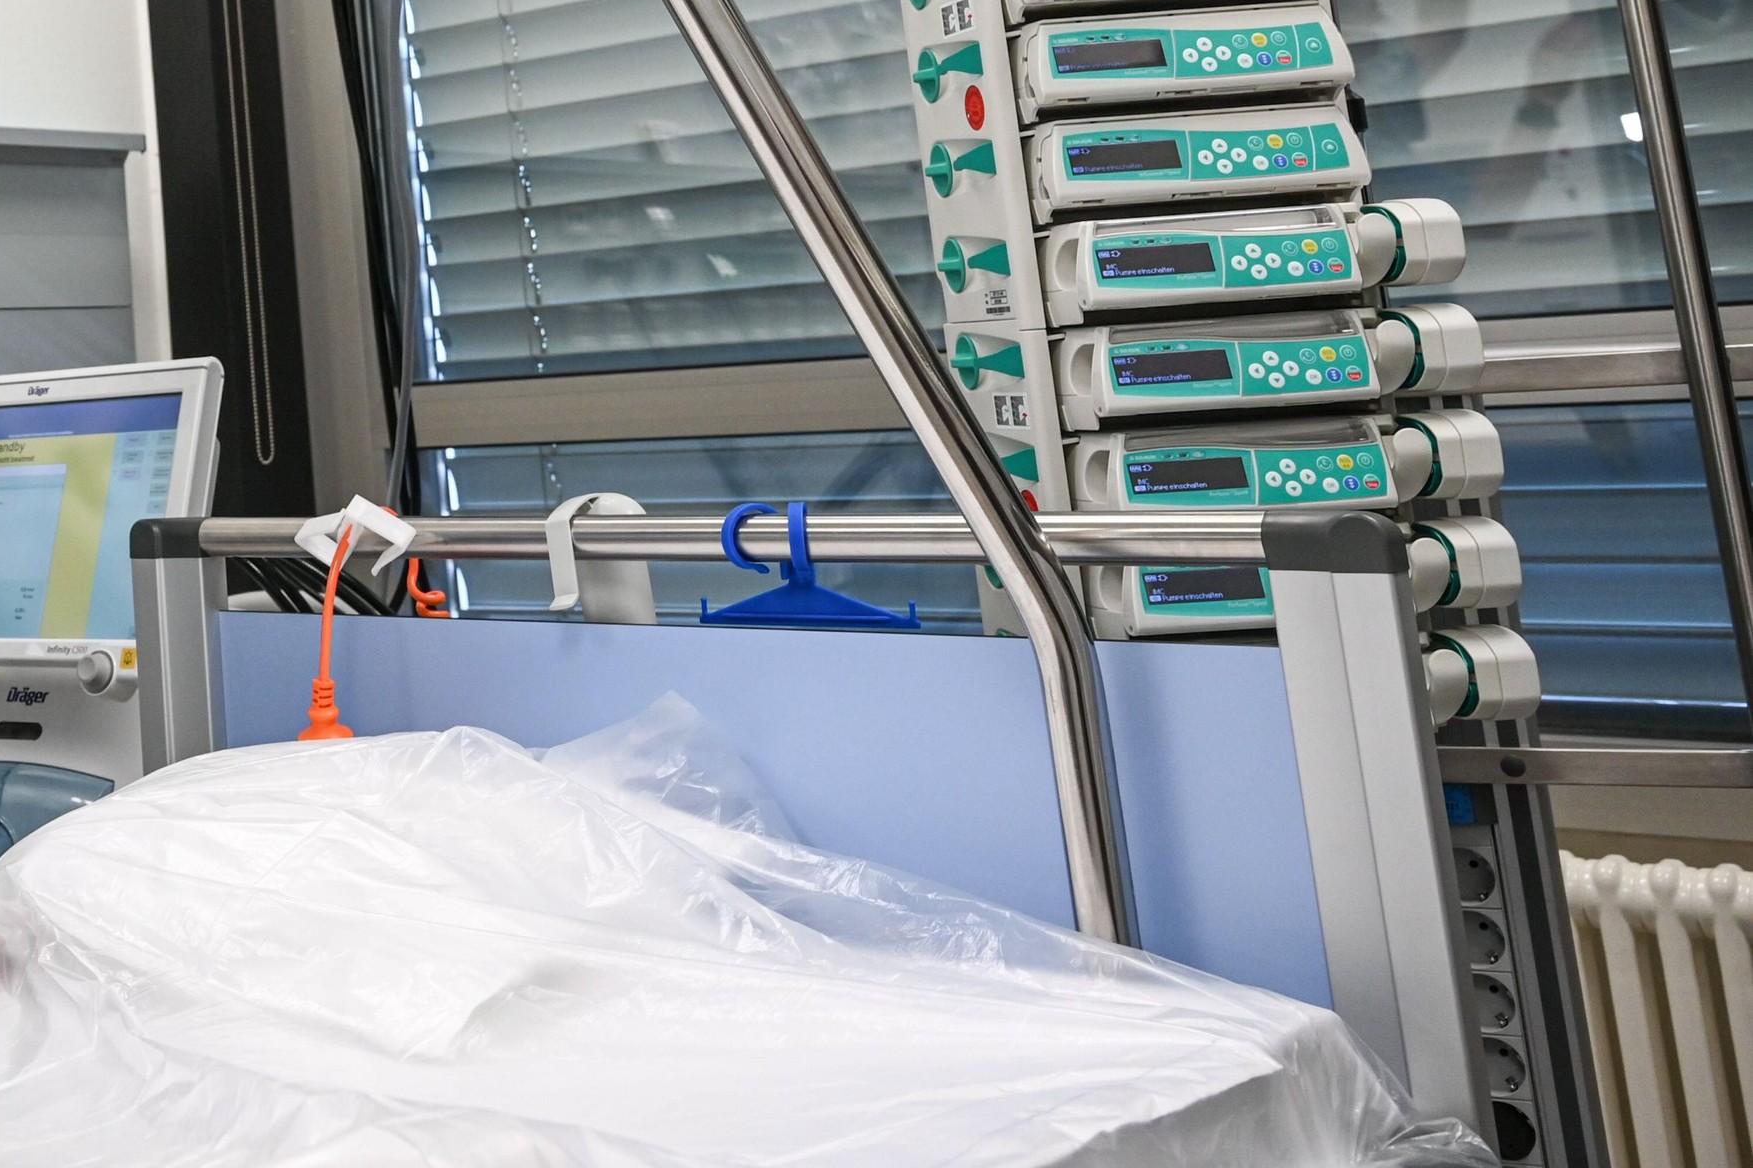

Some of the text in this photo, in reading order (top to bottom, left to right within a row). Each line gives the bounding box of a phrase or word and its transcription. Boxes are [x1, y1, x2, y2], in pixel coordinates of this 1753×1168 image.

[28, 386, 49, 397] Dräger
[47, 645, 88, 655] Infinity C500
[6, 687, 49, 706] Dräger
